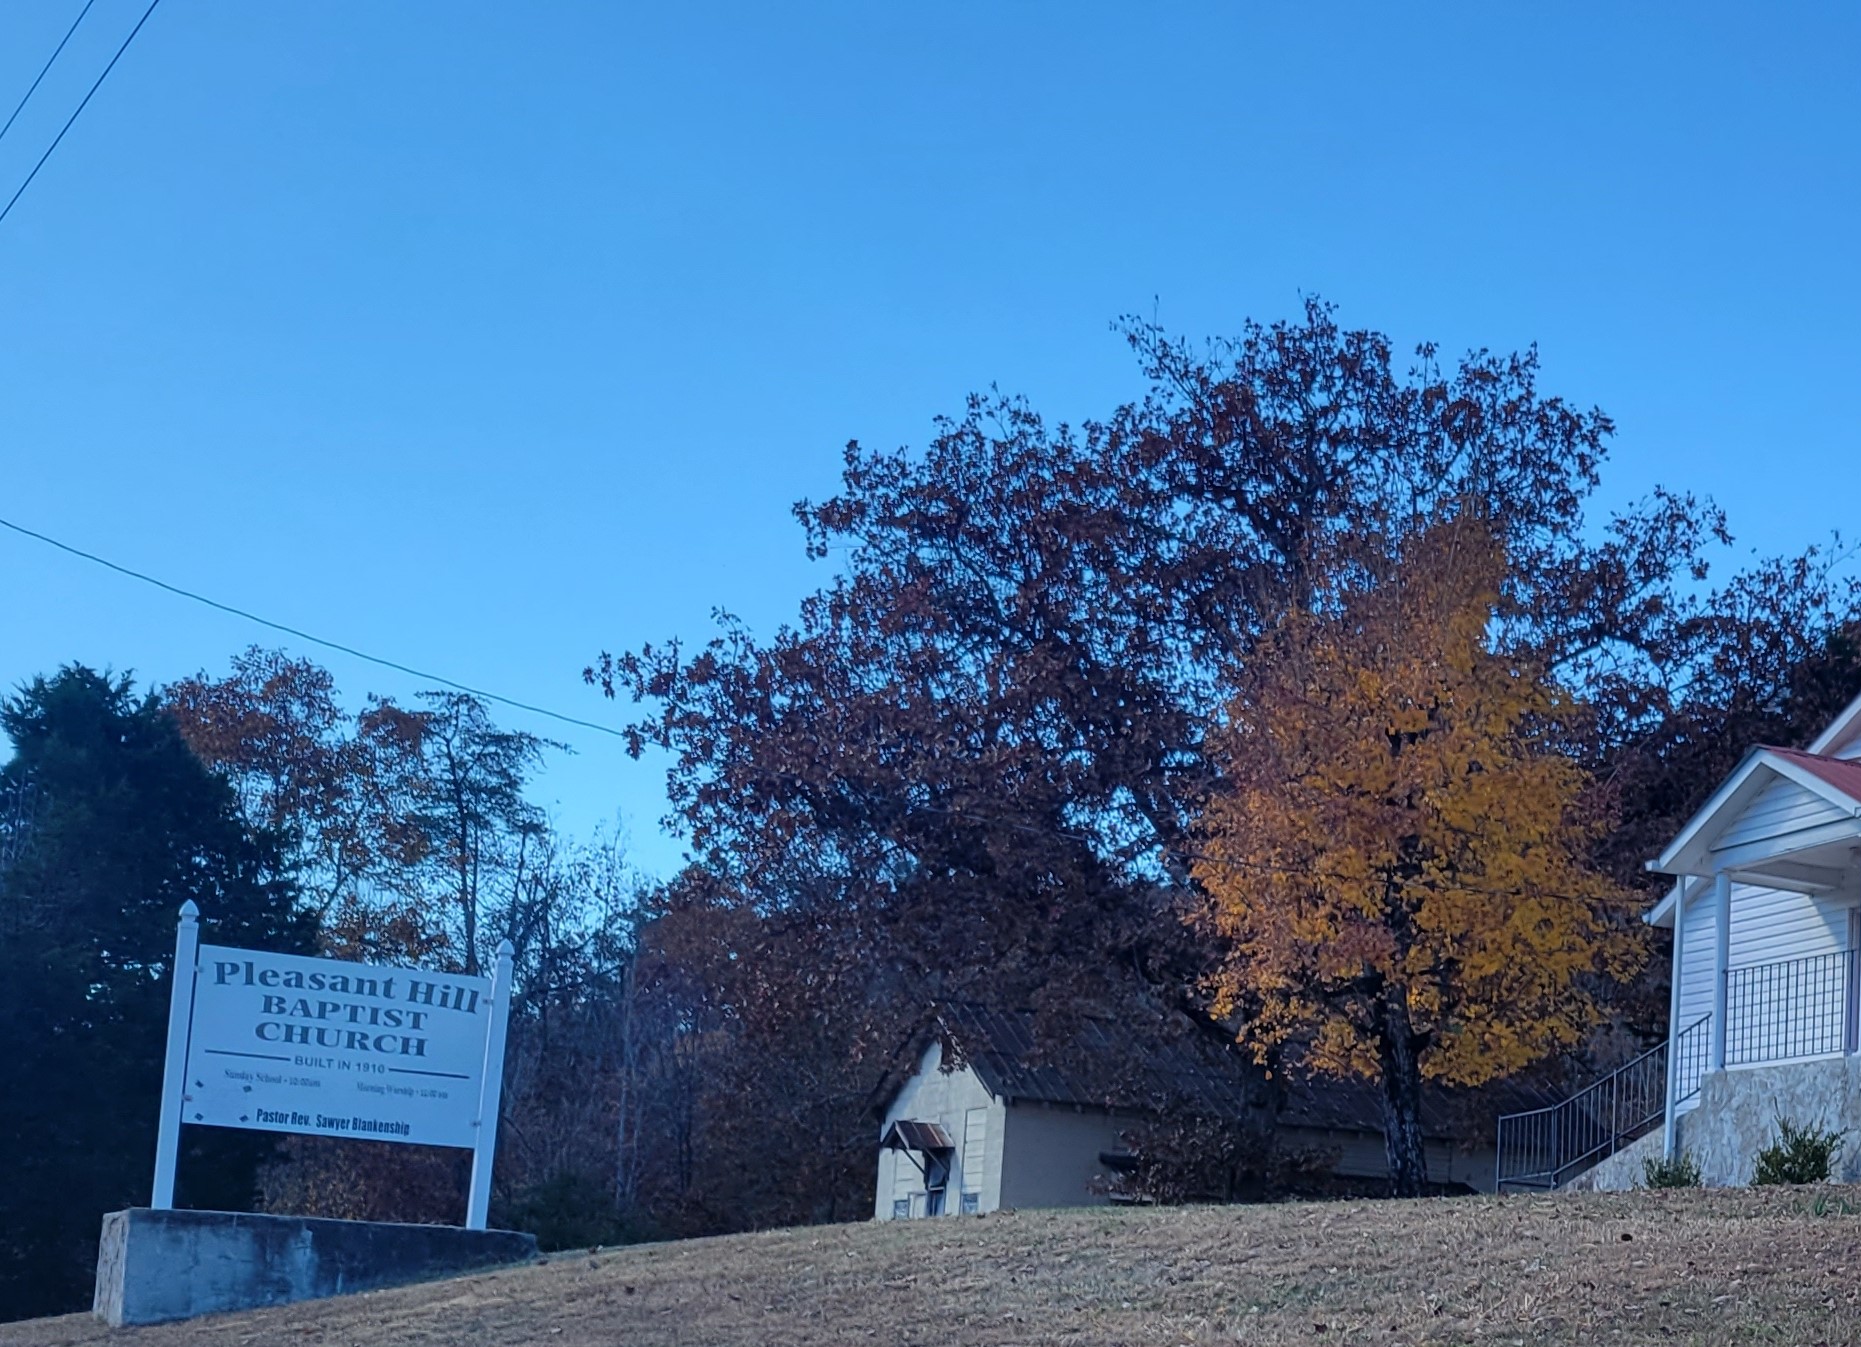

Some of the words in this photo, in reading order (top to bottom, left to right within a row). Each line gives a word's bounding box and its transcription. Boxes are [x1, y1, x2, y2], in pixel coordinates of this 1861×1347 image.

[213, 961, 397, 1000] Pleasant
[406, 979, 479, 1014] Hill
[261, 994, 428, 1031] BAPTIST
[255, 1021, 428, 1057] CHURCH
[294, 1055, 334, 1070] BUILT
[337, 1060, 351, 1071] IN
[355, 1062, 385, 1075] 1910
[256, 1108, 290, 1125] Pastor
[290, 1111, 311, 1126] Rev.
[316, 1114, 350, 1131] Sawyer
[351, 1117, 410, 1136] Blankenship
